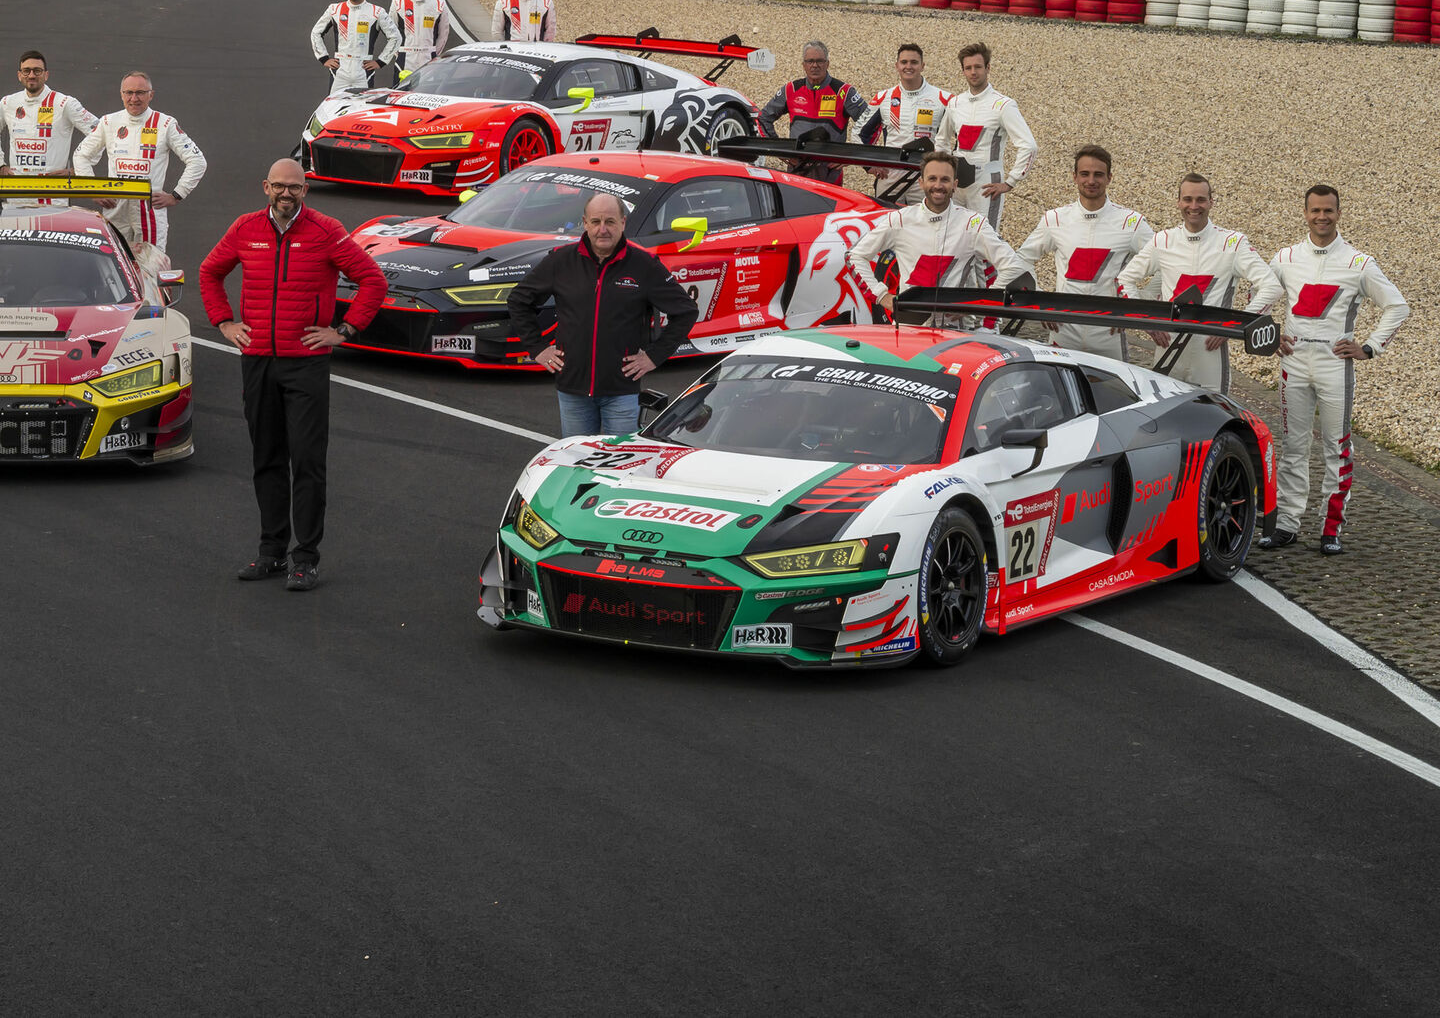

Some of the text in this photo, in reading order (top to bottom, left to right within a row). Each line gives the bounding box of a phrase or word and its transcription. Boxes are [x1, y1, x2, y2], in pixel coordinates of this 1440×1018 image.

[406, 92, 449, 104] Carlisle
[408, 124, 463, 135] COVENTRY
[16, 141, 45, 150] Veedol
[575, 135, 593, 152] 24
[16, 155, 40, 166] TECE
[117, 160, 148, 171] Veedol
[554, 173, 584, 184] GRAN
[585, 178, 636, 196] TURISMO
[38, 230, 102, 246] TURISMO
[735, 256, 760, 267] MOTUL
[689, 268, 721, 277] TotalEnergies
[113, 349, 148, 366] TECE
[814, 376, 938, 405] THE REAL DRIVING SIMULATOR
[816, 367, 949, 401] GRAN TURISMO
[573, 452, 635, 468] 22
[924, 475, 967, 500] FALKE
[1079, 472, 1174, 513] Audi Sport
[1200, 457, 1215, 519] MICHELIN
[625, 501, 728, 530] Castrol
[1023, 500, 1054, 515] TotalEnergies
[1039, 491, 1060, 573] ADAC NORDRHEIN
[1010, 526, 1037, 579] 22
[629, 565, 665, 579] LMS
[921, 546, 933, 605] MICHELIN
[1088, 570, 1135, 592] CASA MODA
[762, 587, 825, 600] Castrol EDGE
[589, 598, 707, 625] Audi Sport
[1017, 603, 1034, 616] Sport
[873, 640, 910, 652] MICHELIN
